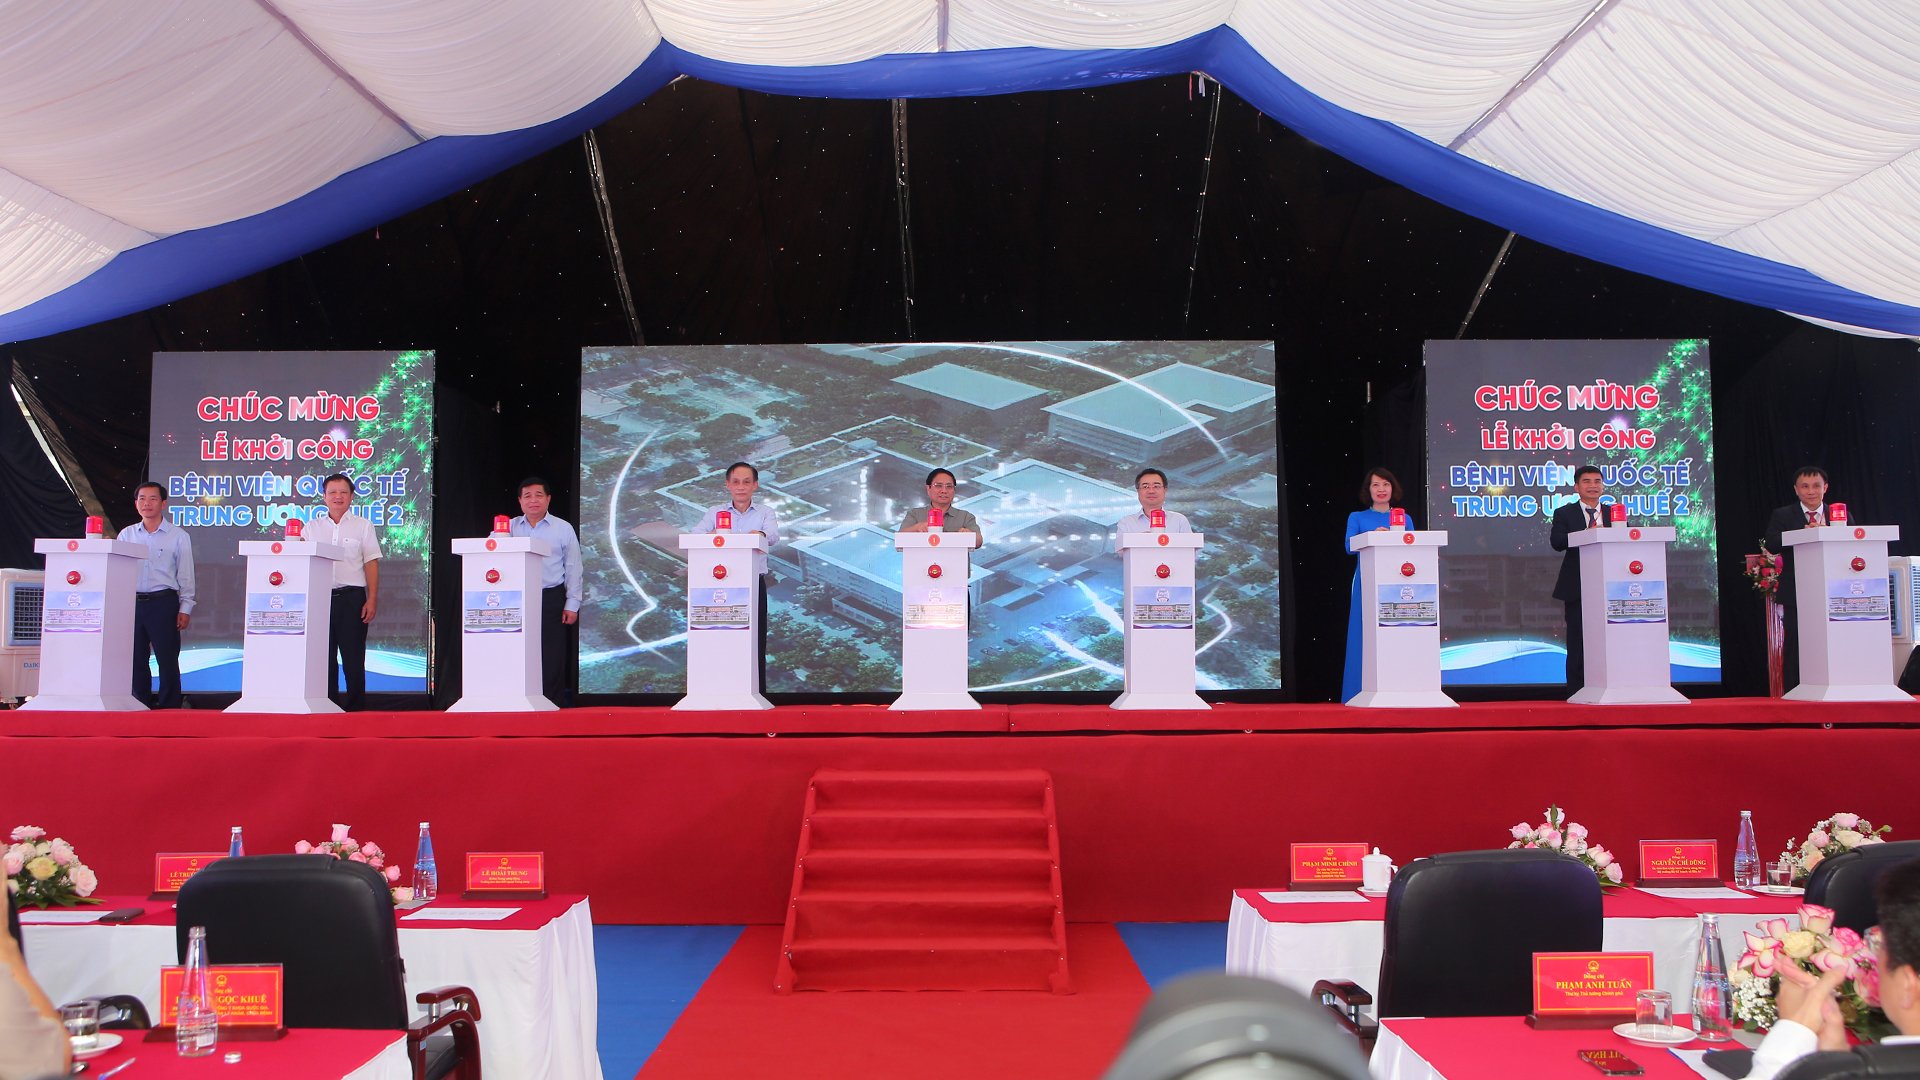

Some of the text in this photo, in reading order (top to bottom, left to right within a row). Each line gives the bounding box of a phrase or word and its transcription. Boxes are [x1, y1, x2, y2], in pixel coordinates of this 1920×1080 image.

[197, 391, 380, 422] CHÚC MỪNG
[1475, 379, 1660, 411] CHÚC MỪNG
[201, 431, 374, 460] LỄ KHỞI CÔNG
[1481, 420, 1656, 450] LỄ KHỞI CÔNG
[169, 471, 231, 502] BỆNH
[236, 471, 292, 502] VIỆN
[377, 468, 409, 497] TẾ
[1450, 457, 1693, 492] BỆNH VIỆN UỐC TẾ
[169, 505, 252, 526] TRUNG
[387, 505, 404, 526] 2
[1452, 495, 1538, 517] TRUNG
[1673, 494, 1689, 516] 2
[217, 995, 239, 1005] GỌC
[240, 993, 268, 1004] KHUÊ
[1556, 979, 1632, 990] PHẠM ANH TUẤN
